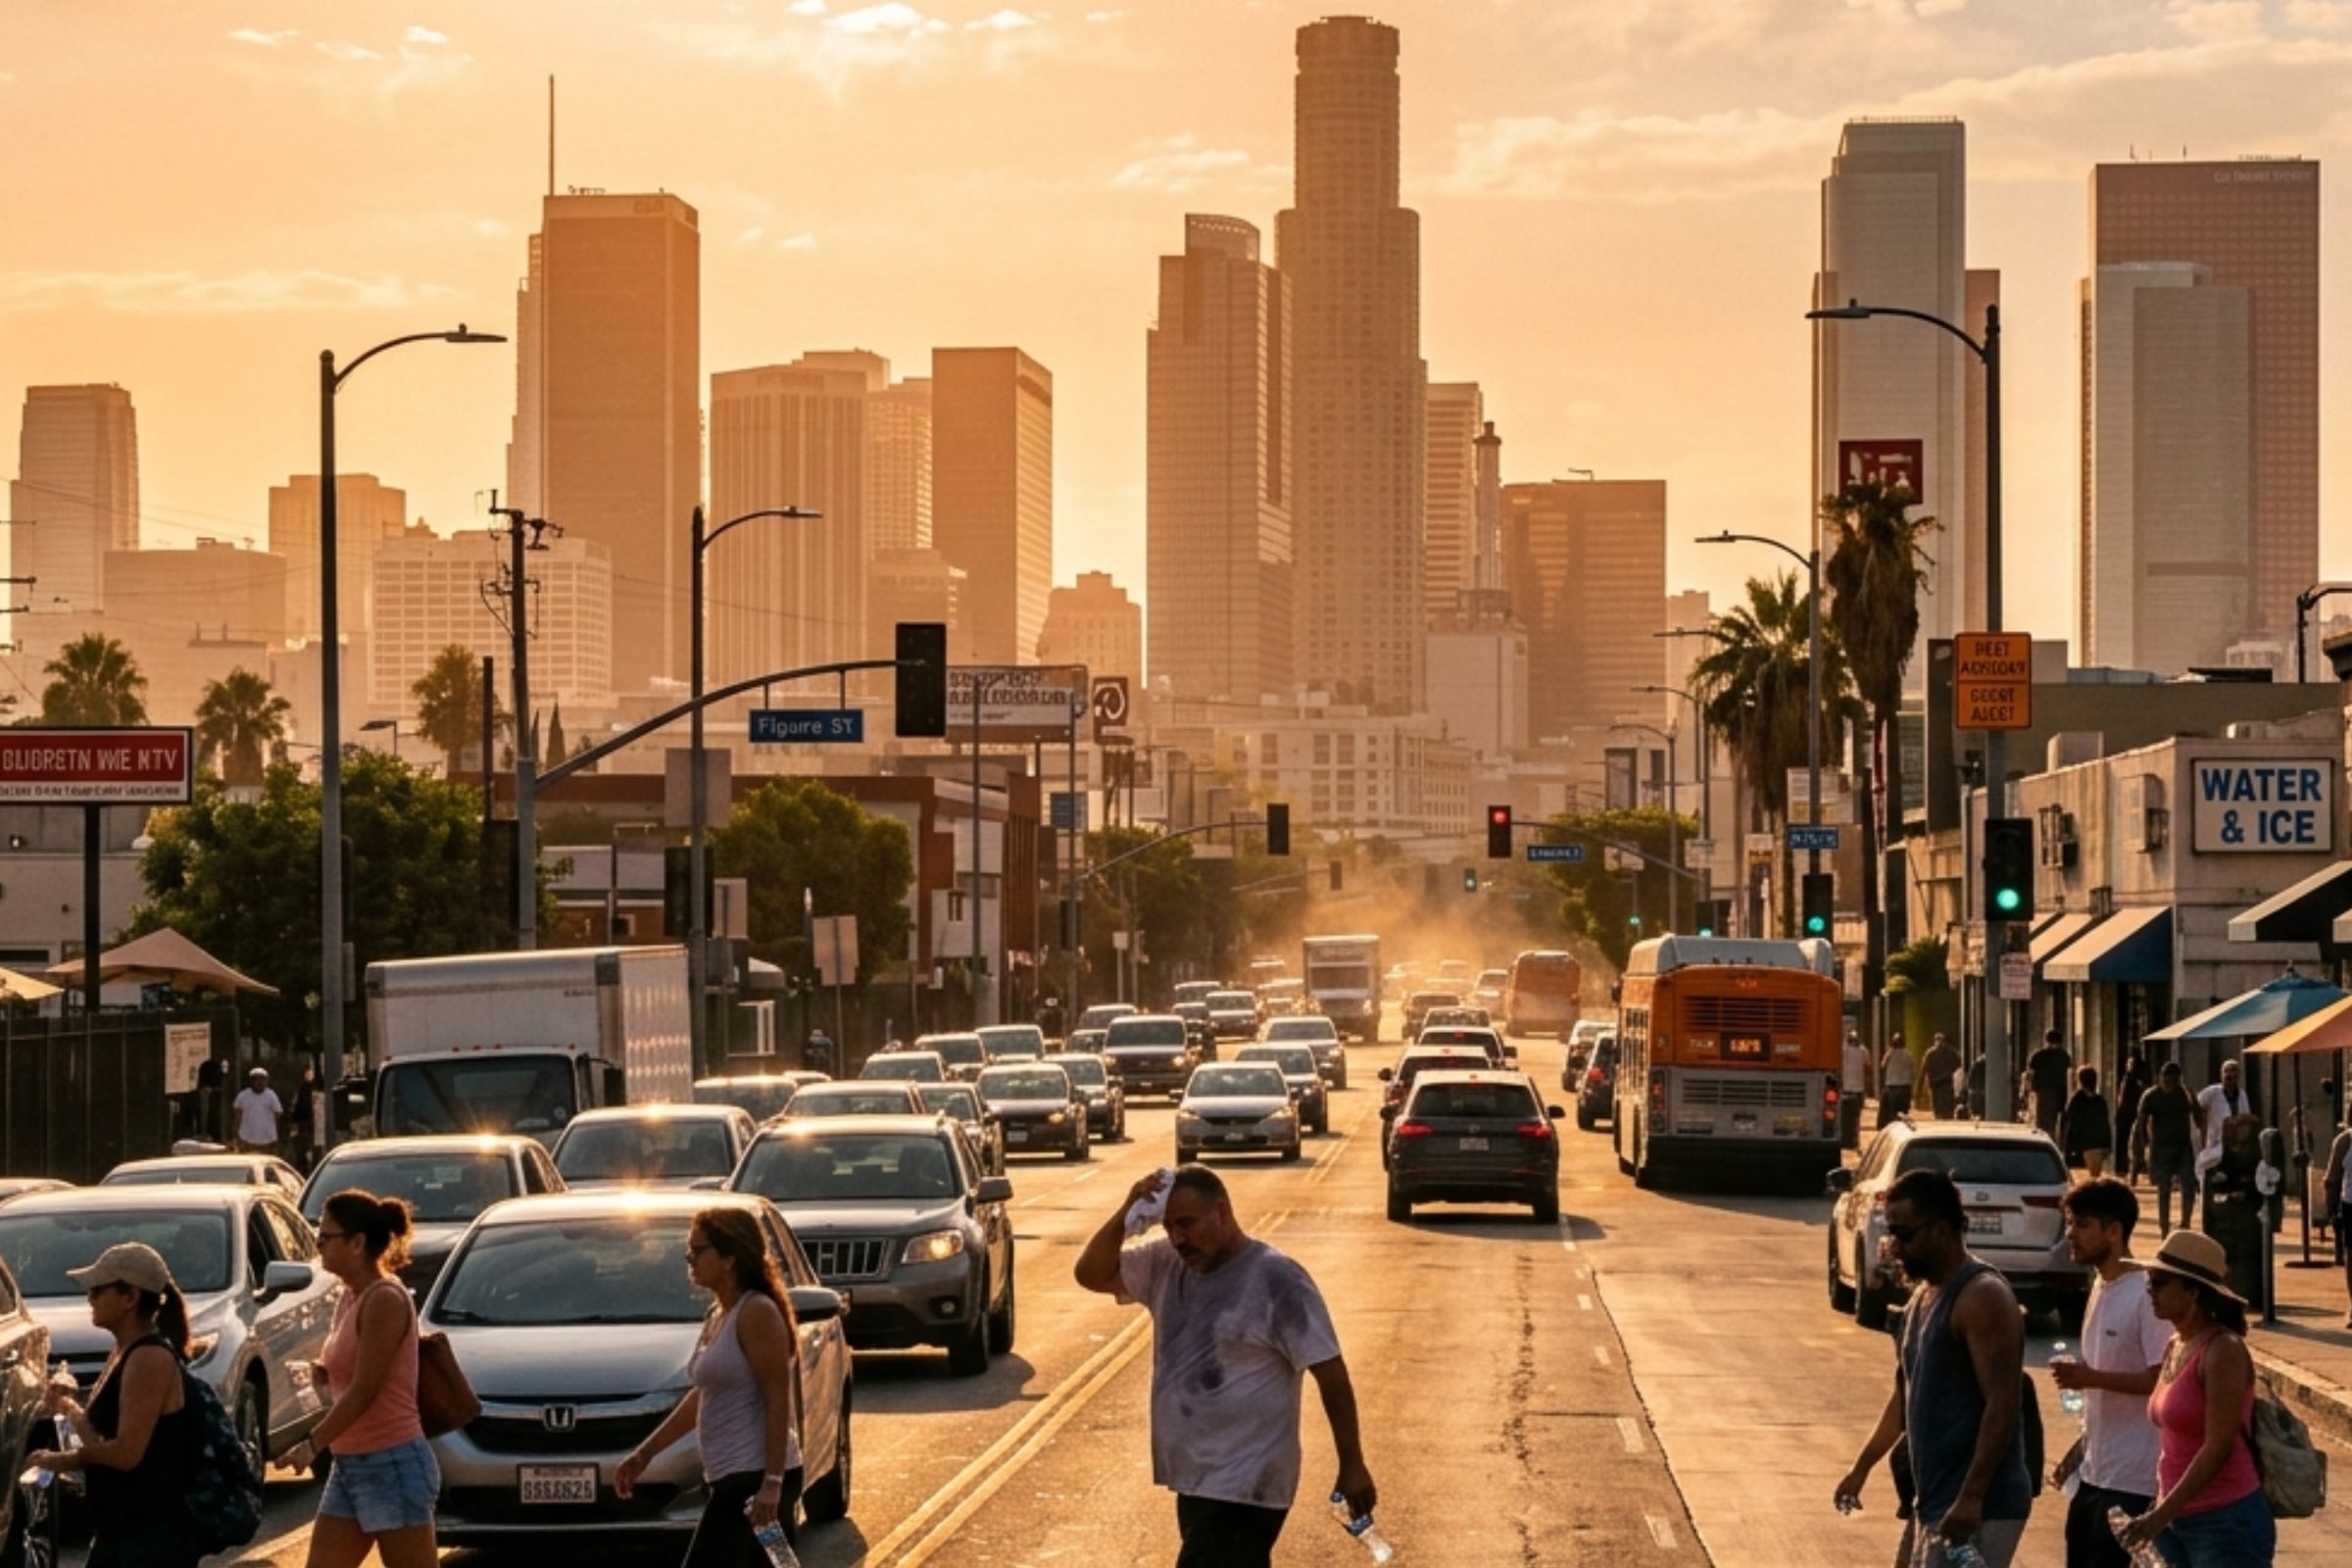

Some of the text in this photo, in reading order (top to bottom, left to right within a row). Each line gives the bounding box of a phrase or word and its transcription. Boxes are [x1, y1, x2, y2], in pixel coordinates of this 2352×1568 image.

[2201, 768, 2323, 802] WATER
[2221, 809, 2316, 844] & ICE
